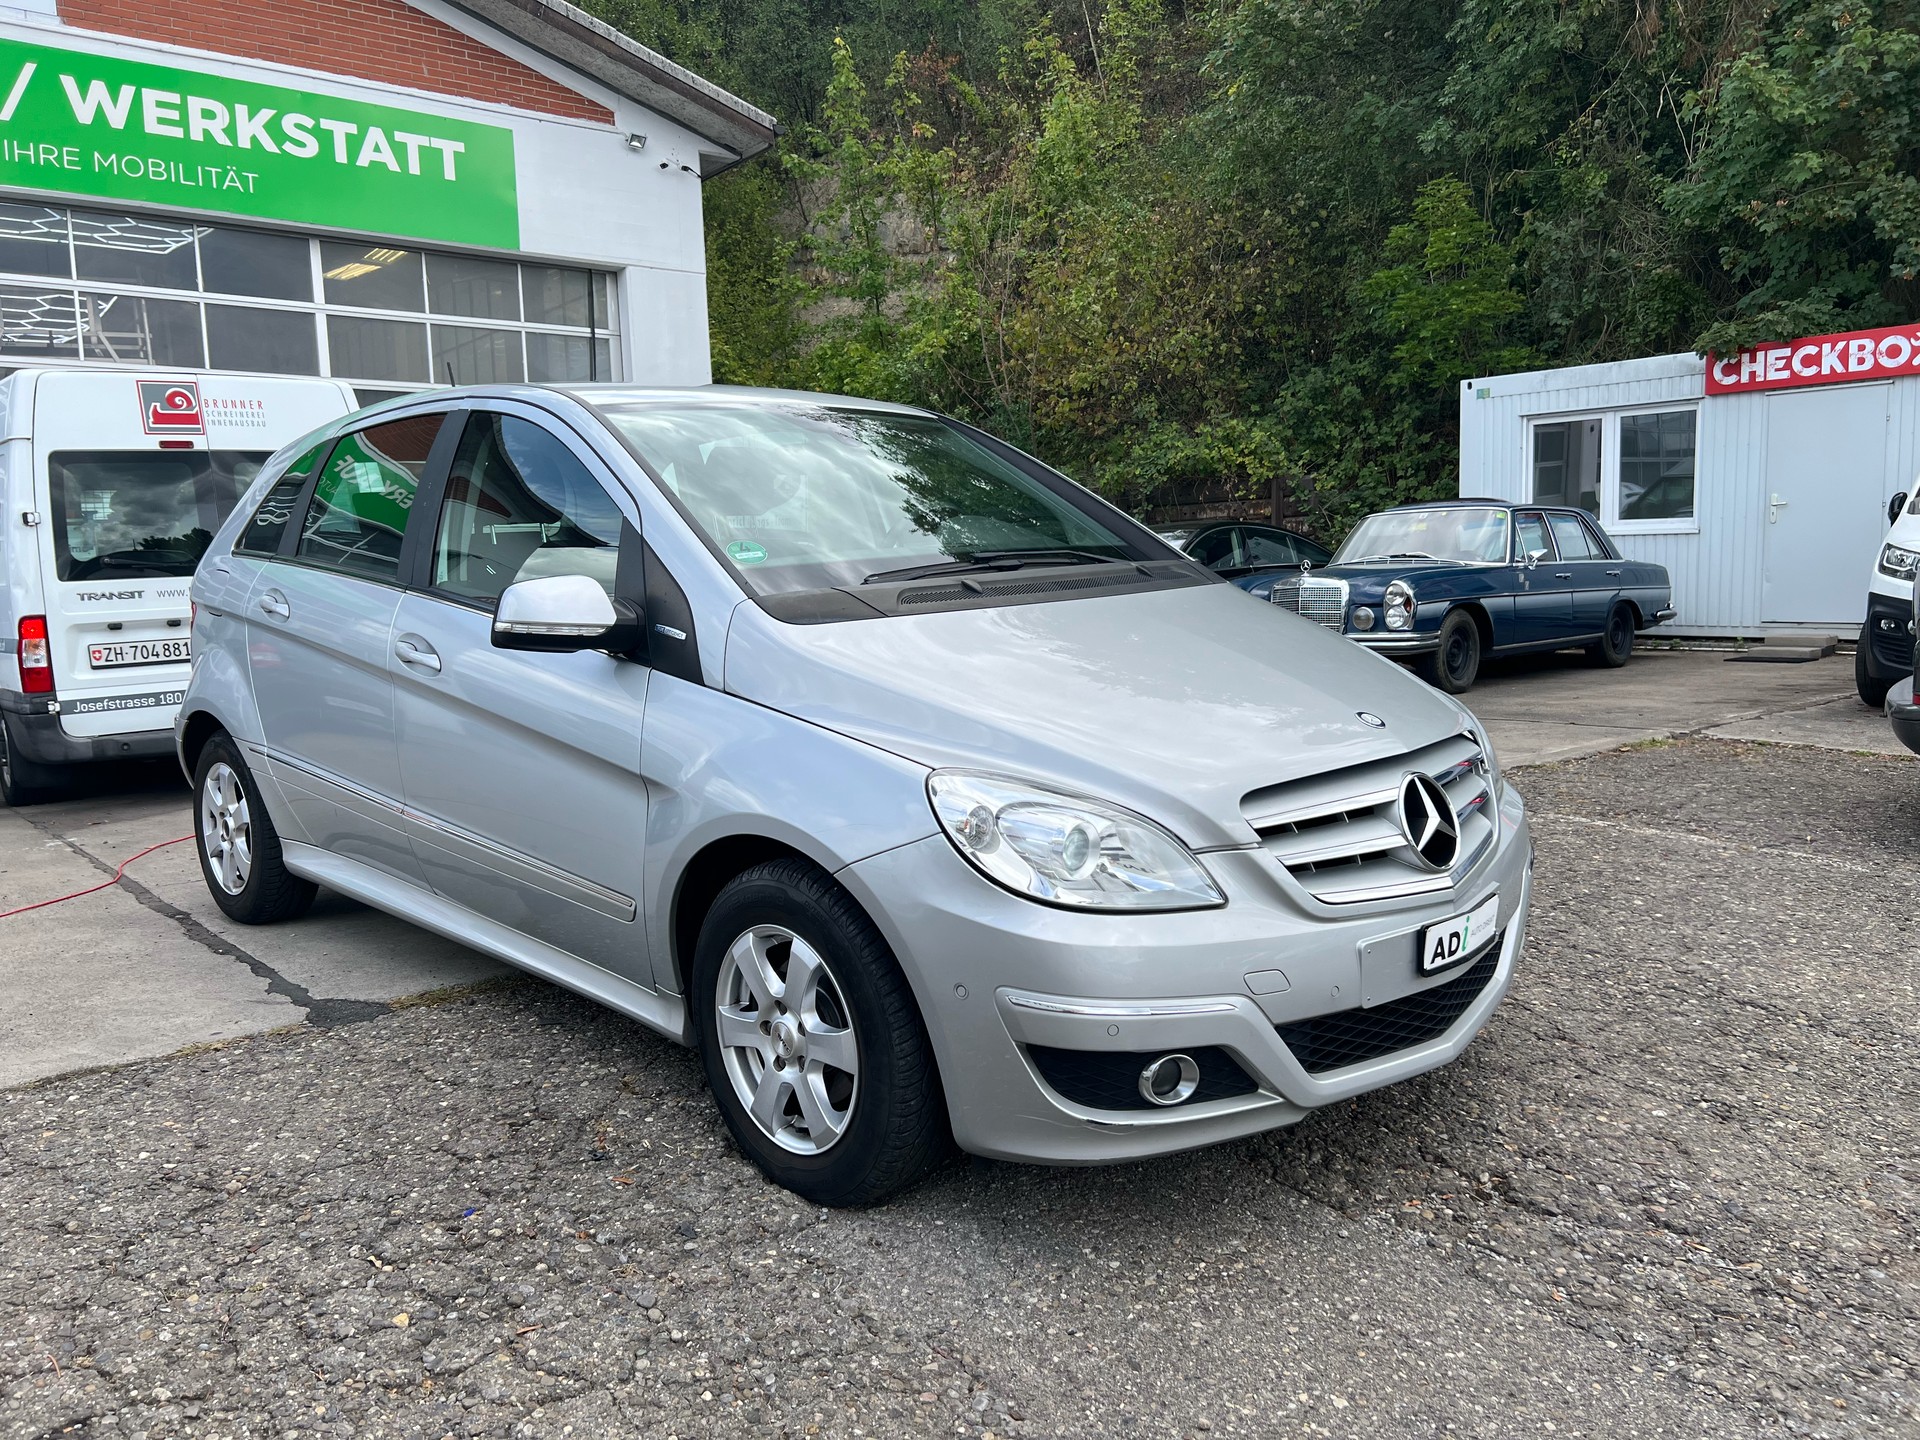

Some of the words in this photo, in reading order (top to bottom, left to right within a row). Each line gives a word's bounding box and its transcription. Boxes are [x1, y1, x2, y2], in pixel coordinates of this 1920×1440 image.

[59, 73, 466, 182] WERKSTATT
[3, 139, 82, 171] IHRE
[93, 151, 260, 195] MOBILITÄT
[203, 398, 264, 410] BRUNNER
[205, 410, 266, 419] SCHREINEREI
[206, 419, 267, 428] INNENAUSBAU
[76, 590, 145, 601] TRANSIT
[73, 697, 156, 713] Josefstrasse
[159, 692, 183, 705] 180
